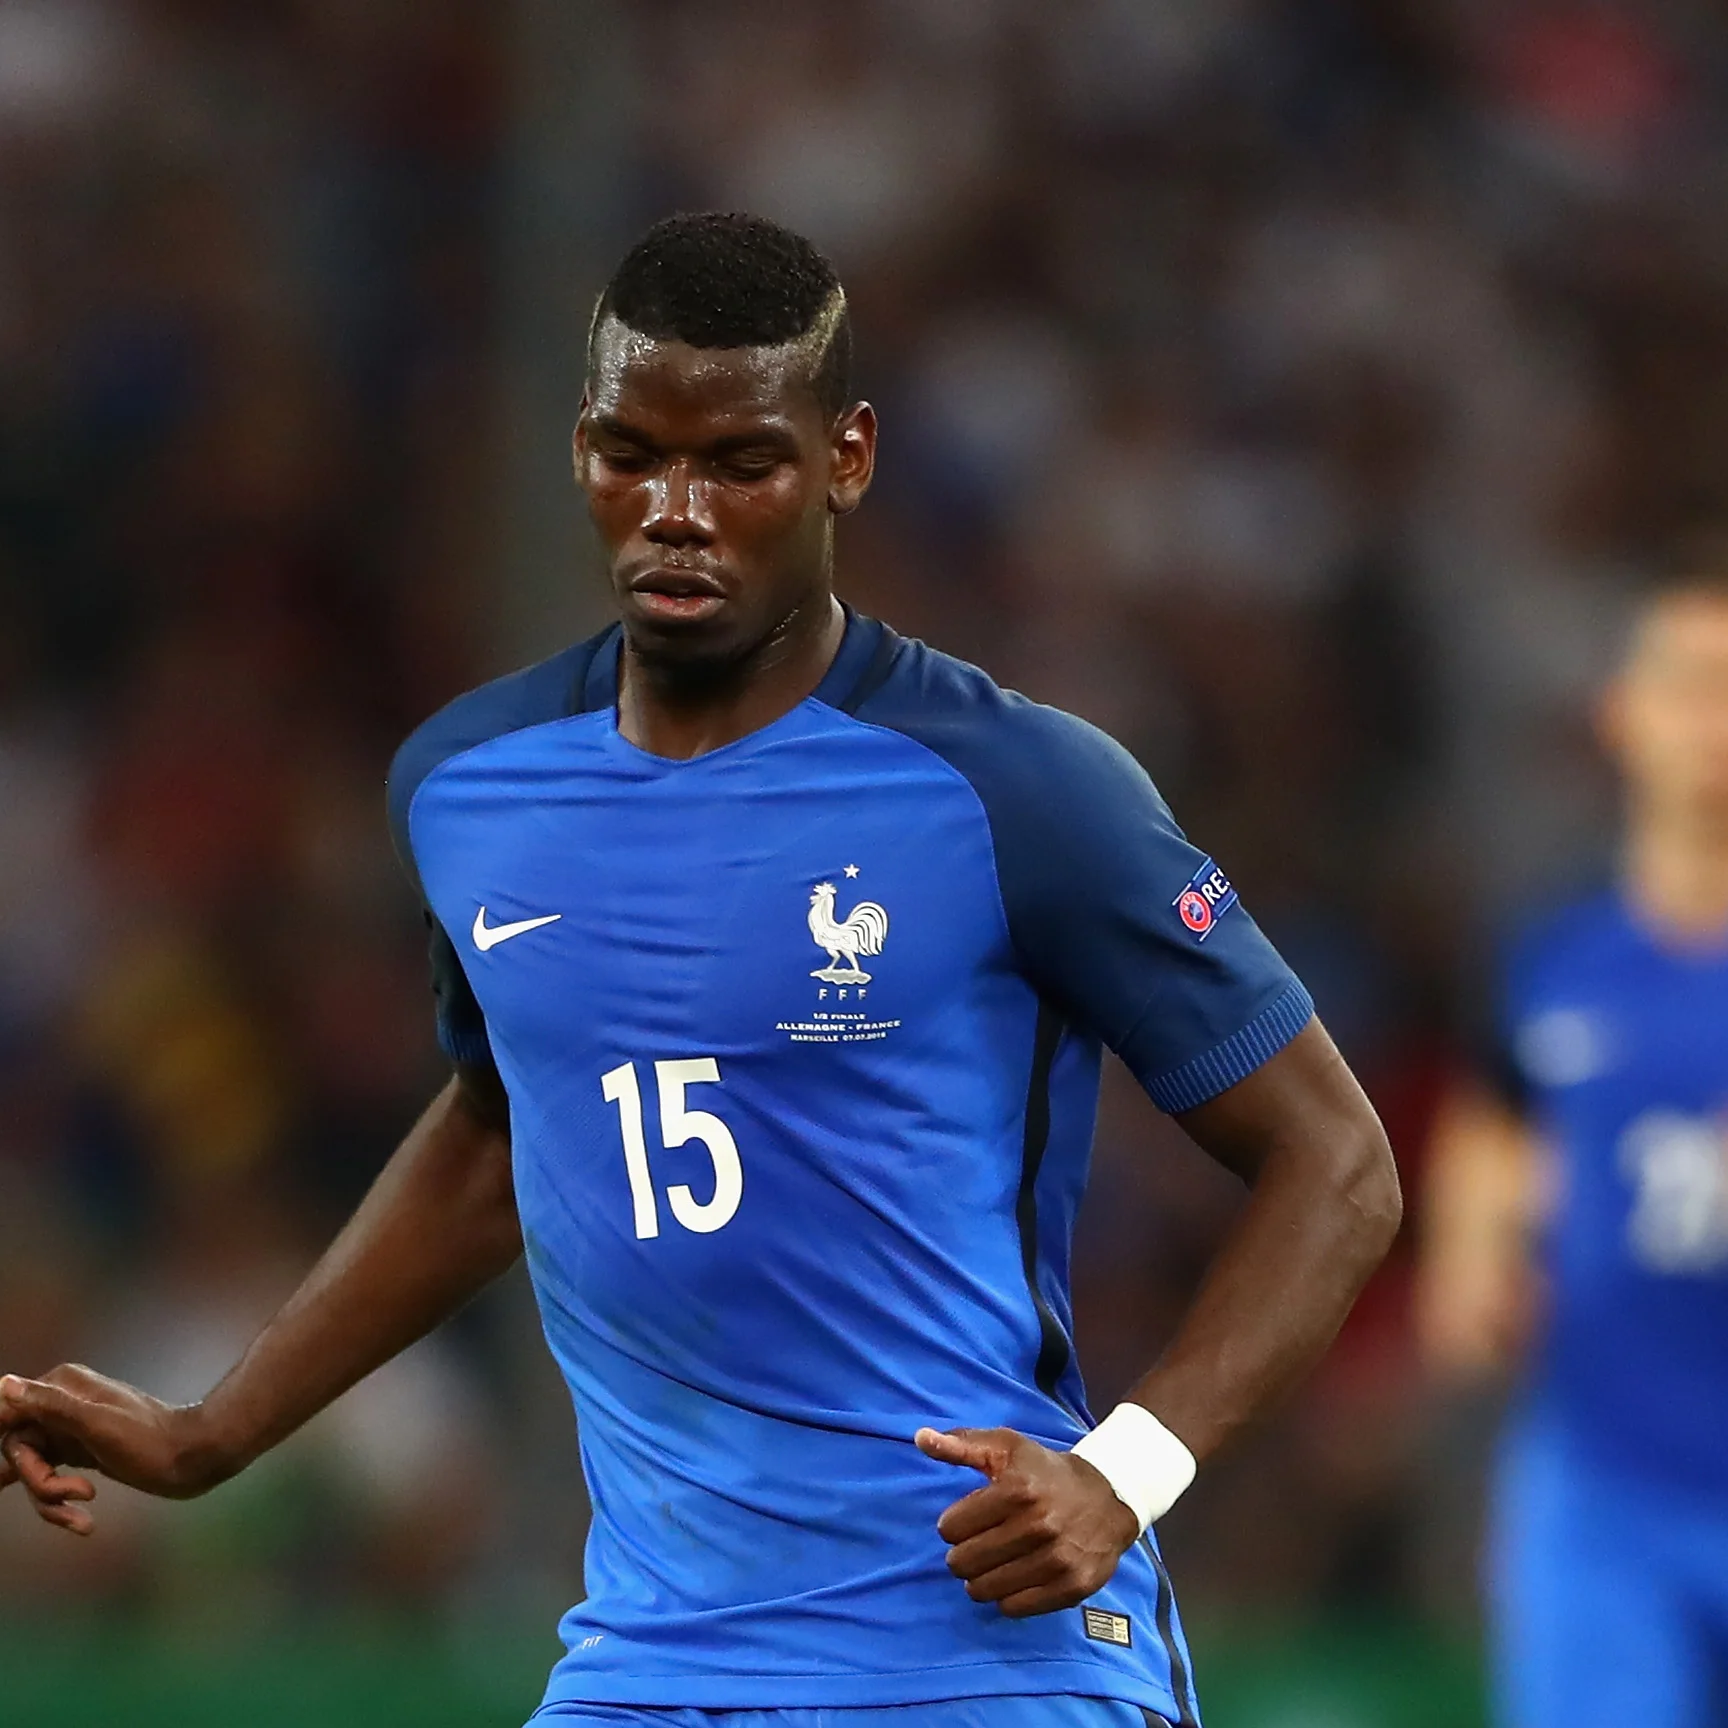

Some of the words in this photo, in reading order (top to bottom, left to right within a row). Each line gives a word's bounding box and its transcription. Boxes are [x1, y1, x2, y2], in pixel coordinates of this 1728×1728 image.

[775, 1022, 846, 1031] ALLEMAGNE
[856, 1020, 901, 1030] FRANCE
[790, 1034, 839, 1042] MARSEILLE
[601, 1057, 744, 1240] 15
